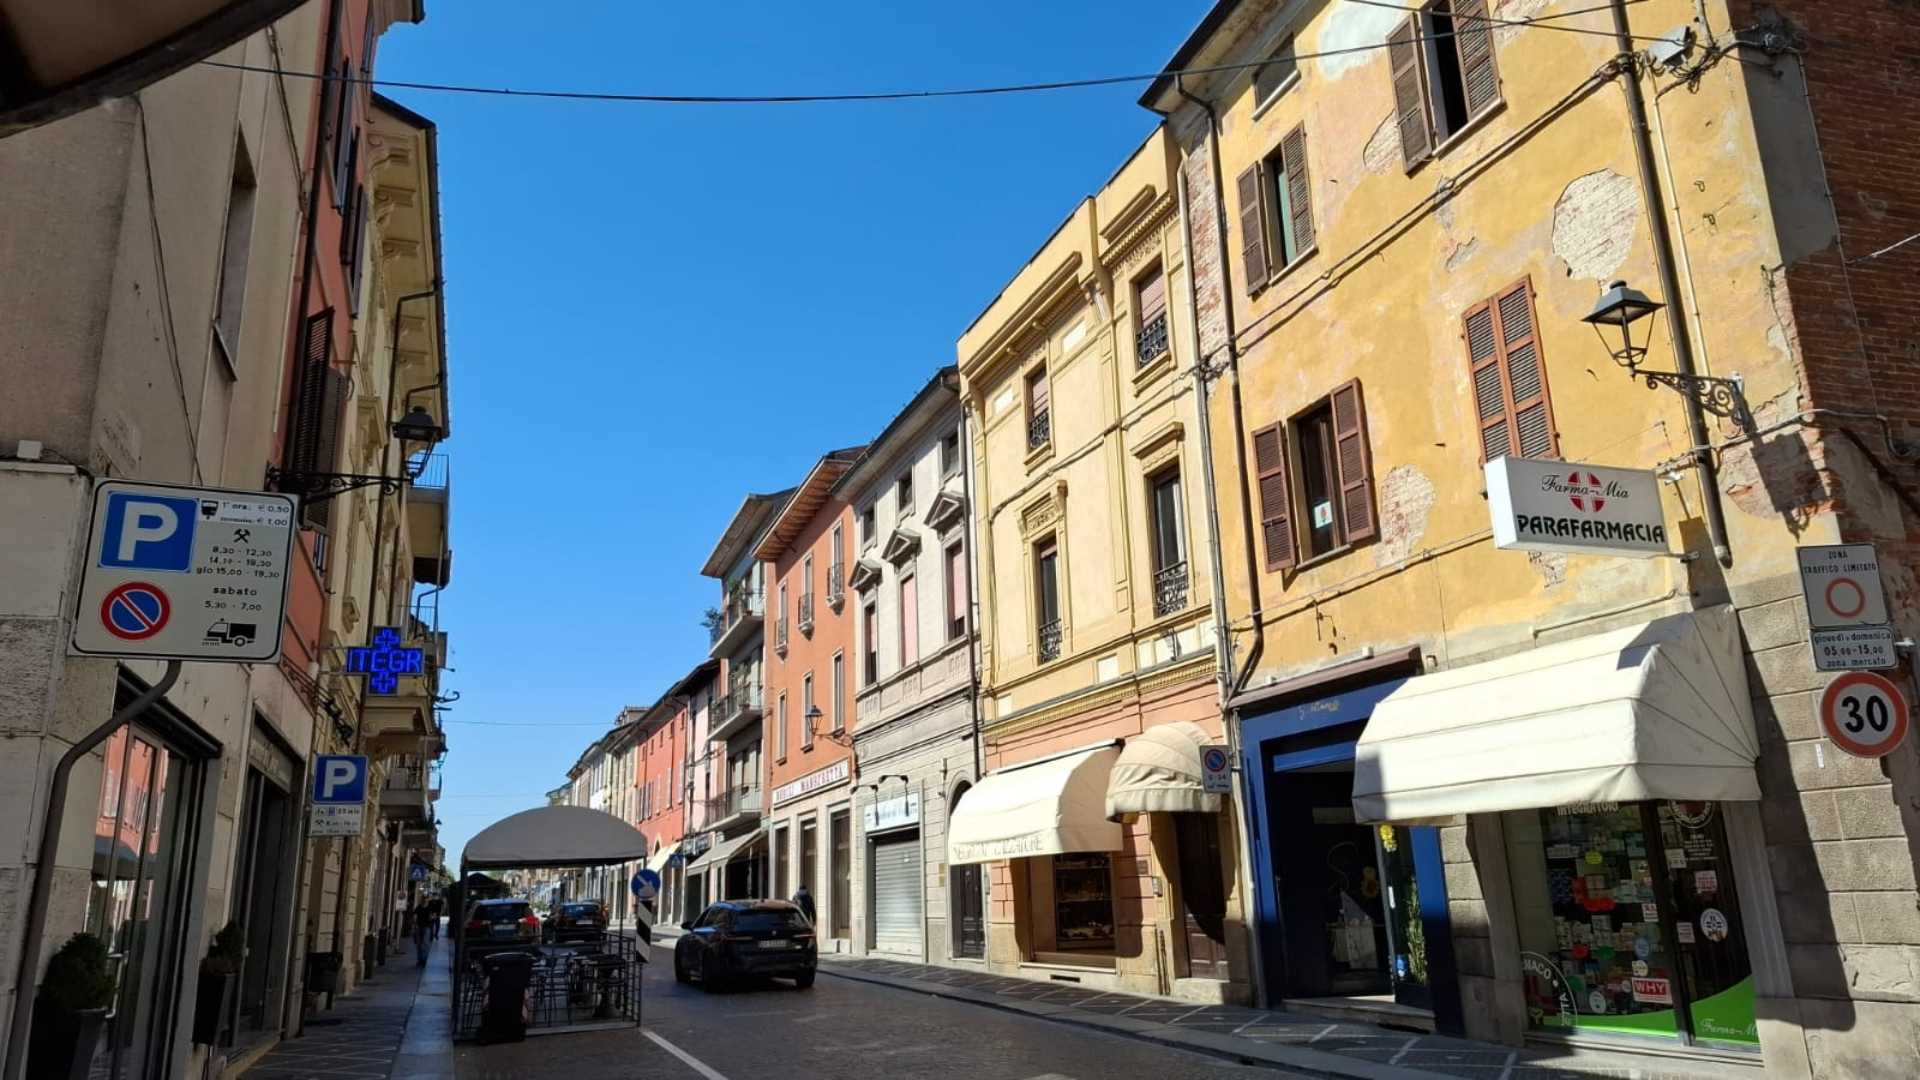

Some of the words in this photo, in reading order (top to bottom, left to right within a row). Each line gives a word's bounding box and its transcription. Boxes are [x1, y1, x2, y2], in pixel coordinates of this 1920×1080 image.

[118, 501, 178, 561] P
[1517, 514, 1666, 543] PARAFARMACIA
[1804, 564, 1840, 575] TRAFFICO
[1843, 562, 1877, 573] LIMITATO
[212, 586, 257, 596] sabato
[1841, 695, 1889, 733] 30
[322, 759, 357, 798] P
[1634, 980, 1667, 995] WHY
